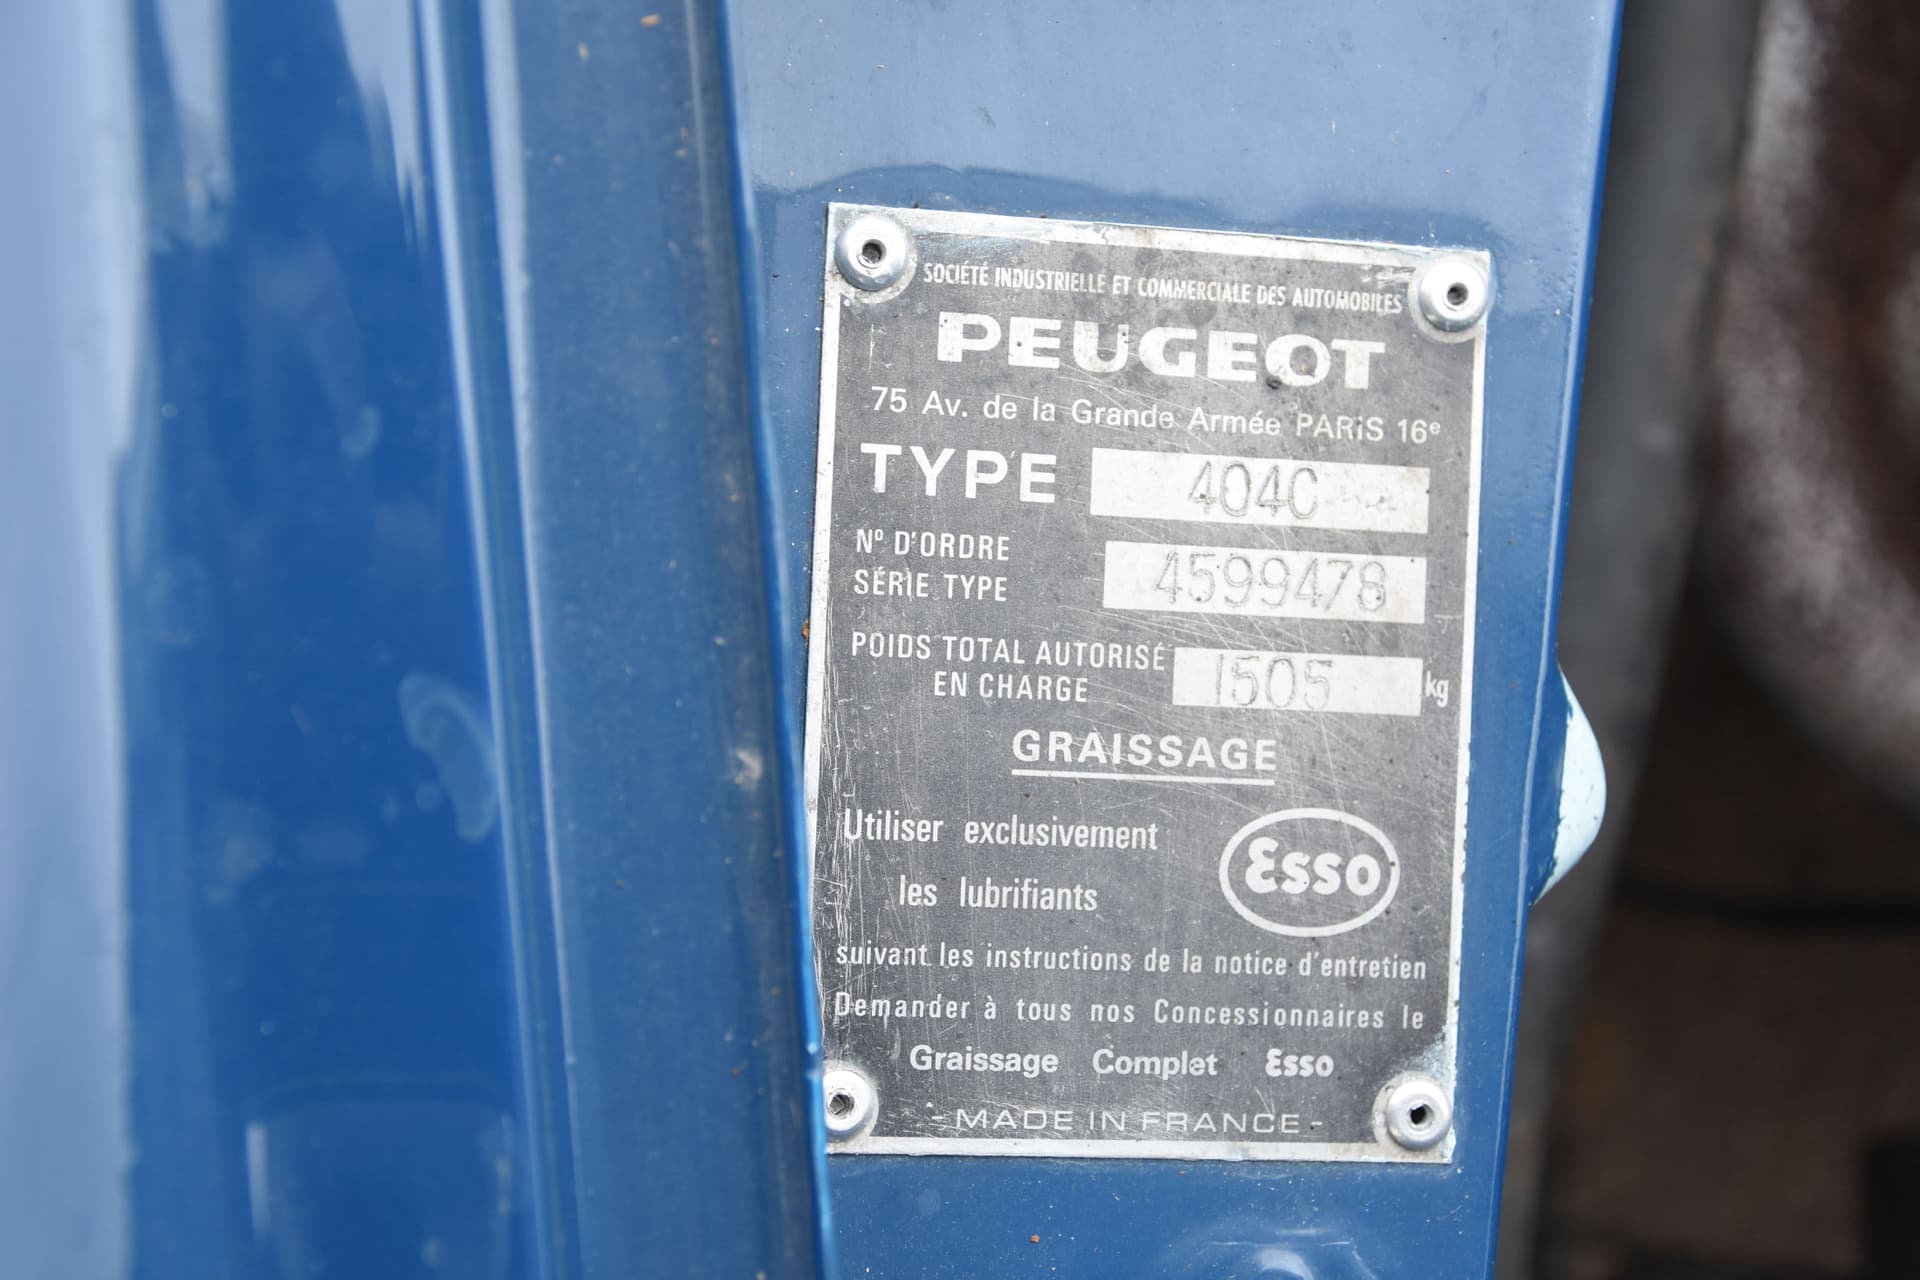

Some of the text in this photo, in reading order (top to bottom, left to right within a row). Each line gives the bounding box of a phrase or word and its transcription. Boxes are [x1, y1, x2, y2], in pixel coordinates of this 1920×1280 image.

[924, 259, 1403, 313] SOCIÉTÉ INDUSTRIELLE ET COMMERCIALE DES AUTOMOBILES
[937, 311, 1385, 389] PEUGEOT
[871, 386, 907, 413] 75
[922, 390, 967, 416] Av.
[983, 393, 1018, 419] de
[1033, 396, 1055, 422] la
[1072, 399, 1174, 428] Grande
[1188, 408, 1281, 436] Armée
[860, 442, 1318, 520] TYPE 404C
[895, 531, 1009, 560] D'ORDRE
[854, 551, 1388, 612] SÉRIE TYPE 4599478
[851, 632, 1165, 671] POIDS TOTAL AUTORISÉ
[934, 654, 1449, 709] EN CHARGE 1505 kg
[1012, 728, 1276, 771] GRAISSAGE
[844, 810, 1158, 851] Utiliser exclusivement
[1245, 837, 1381, 896] Esso
[900, 875, 1098, 911] les lubrifiants
[836, 941, 1426, 980] suivant les instructions de la notice d'entretien
[835, 992, 1423, 1030] Demander à tous nos Concessionnaires le
[909, 1044, 1333, 1079] Graissage Complet Esso
[957, 1109, 1072, 1131] MADE
[1088, 1110, 1128, 1132] IN
[1143, 1111, 1297, 1135] FRANCE
